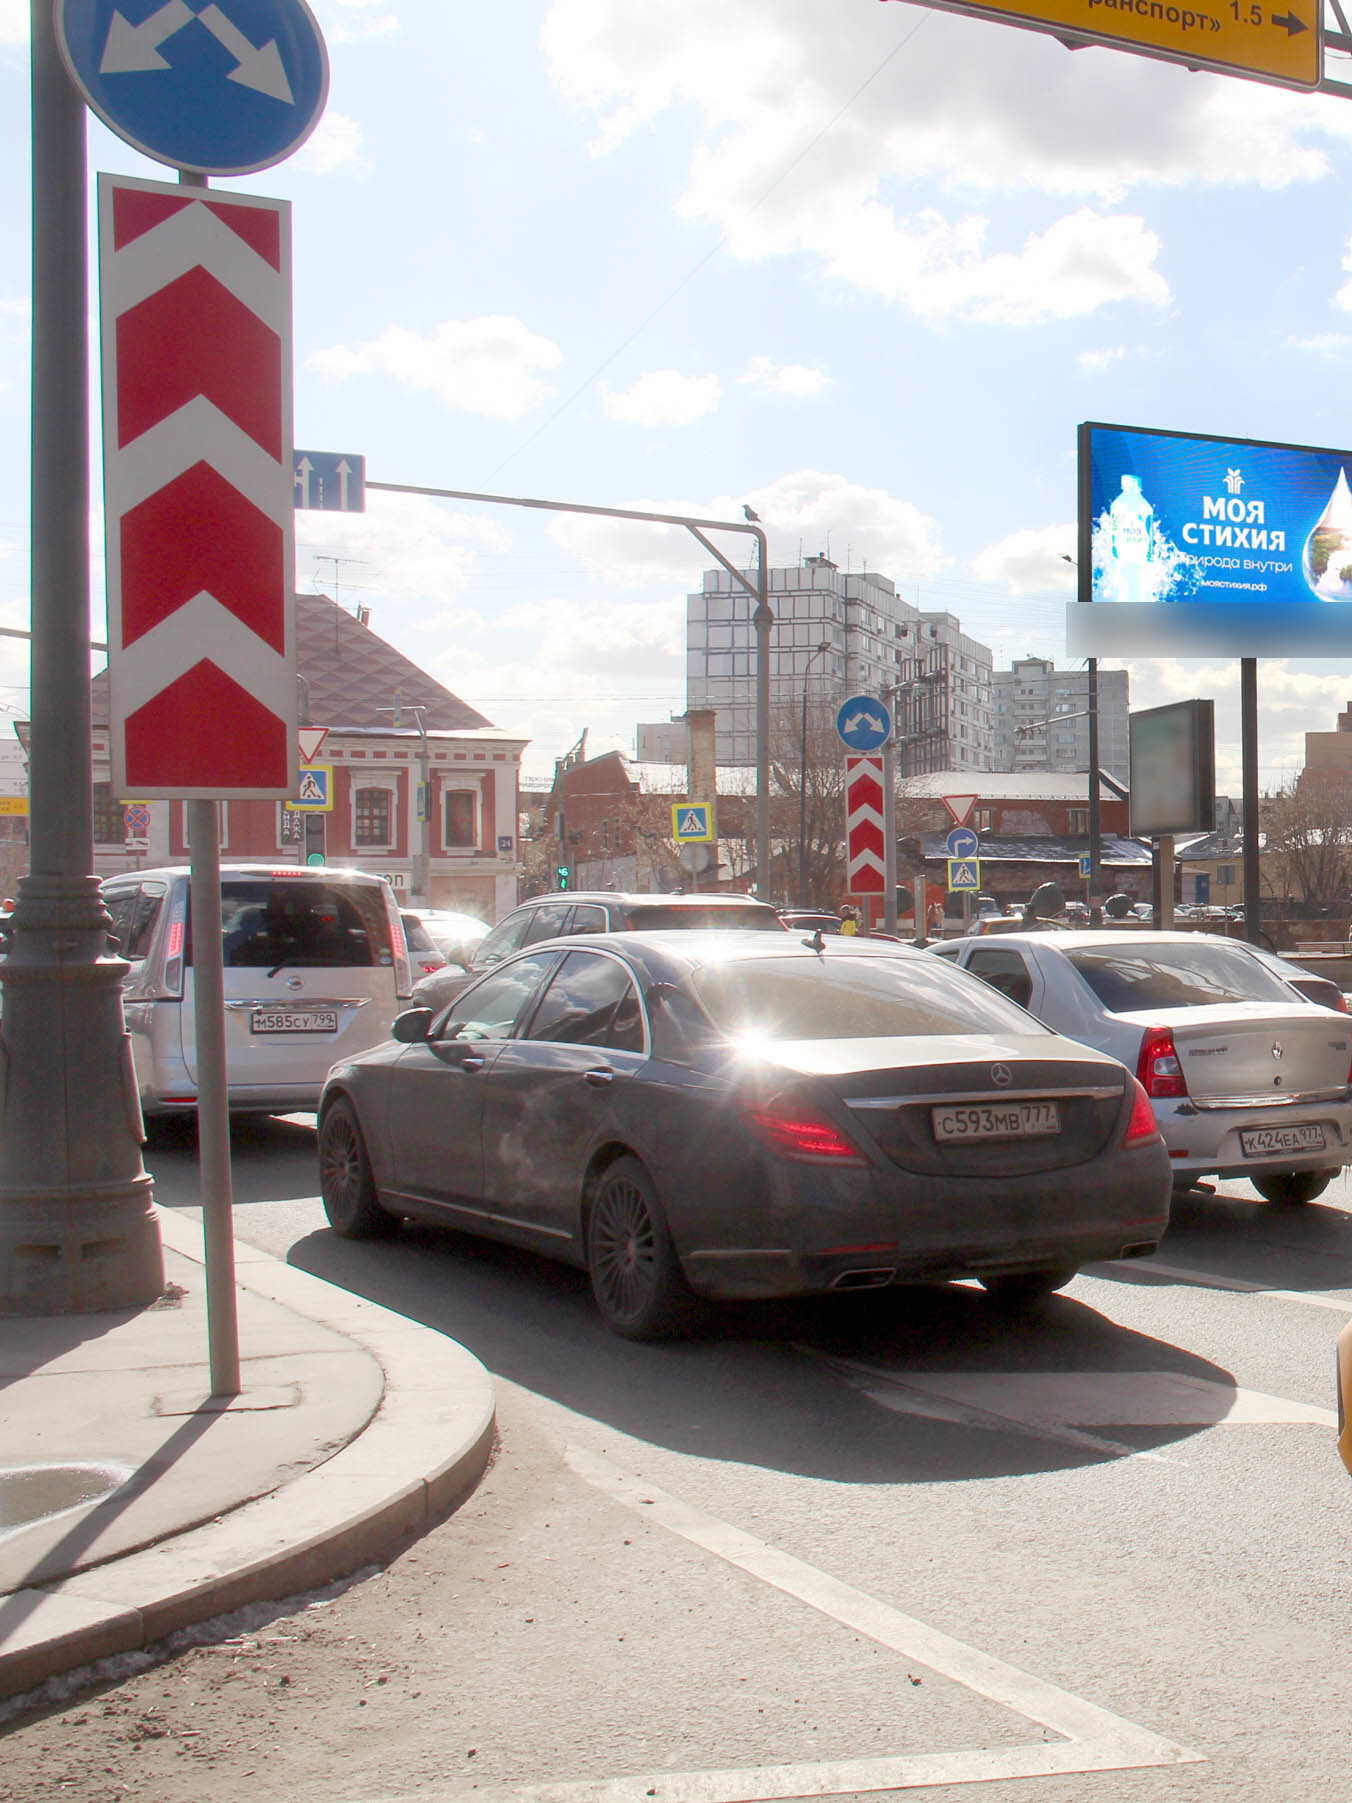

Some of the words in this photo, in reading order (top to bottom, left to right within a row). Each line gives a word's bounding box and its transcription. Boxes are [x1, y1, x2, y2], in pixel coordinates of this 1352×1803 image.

[1230, 0, 1263, 26] 1.5
[1203, 496, 1265, 524] МОЯ
[1181, 523, 1286, 552] СТИХИЯ
[1243, 559, 1293, 574] внутри
